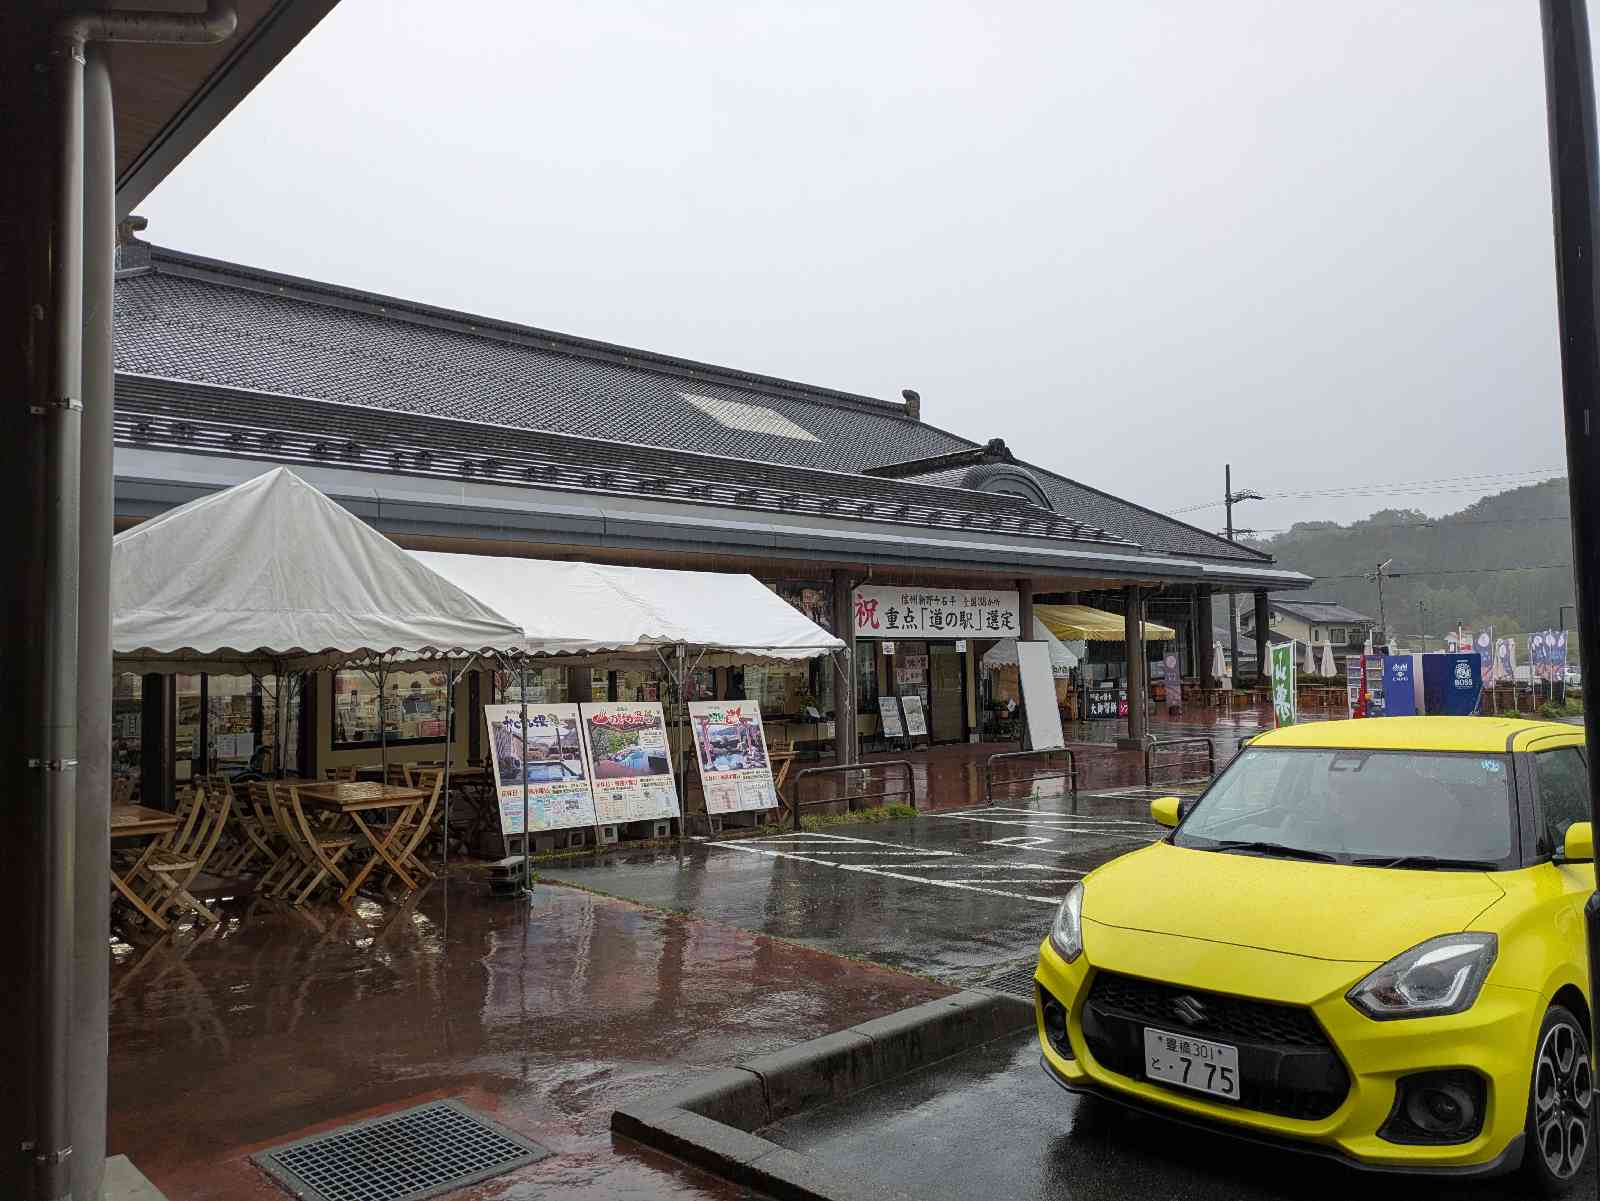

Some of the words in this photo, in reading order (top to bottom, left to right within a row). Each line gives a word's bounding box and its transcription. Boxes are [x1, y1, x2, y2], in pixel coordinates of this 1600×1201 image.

[854, 593, 881, 630] 祝
[884, 607, 1016, 631] 重点「道の駅」選定
[1454, 678, 1473, 686] BOSS
[1151, 1056, 1162, 1071] と
